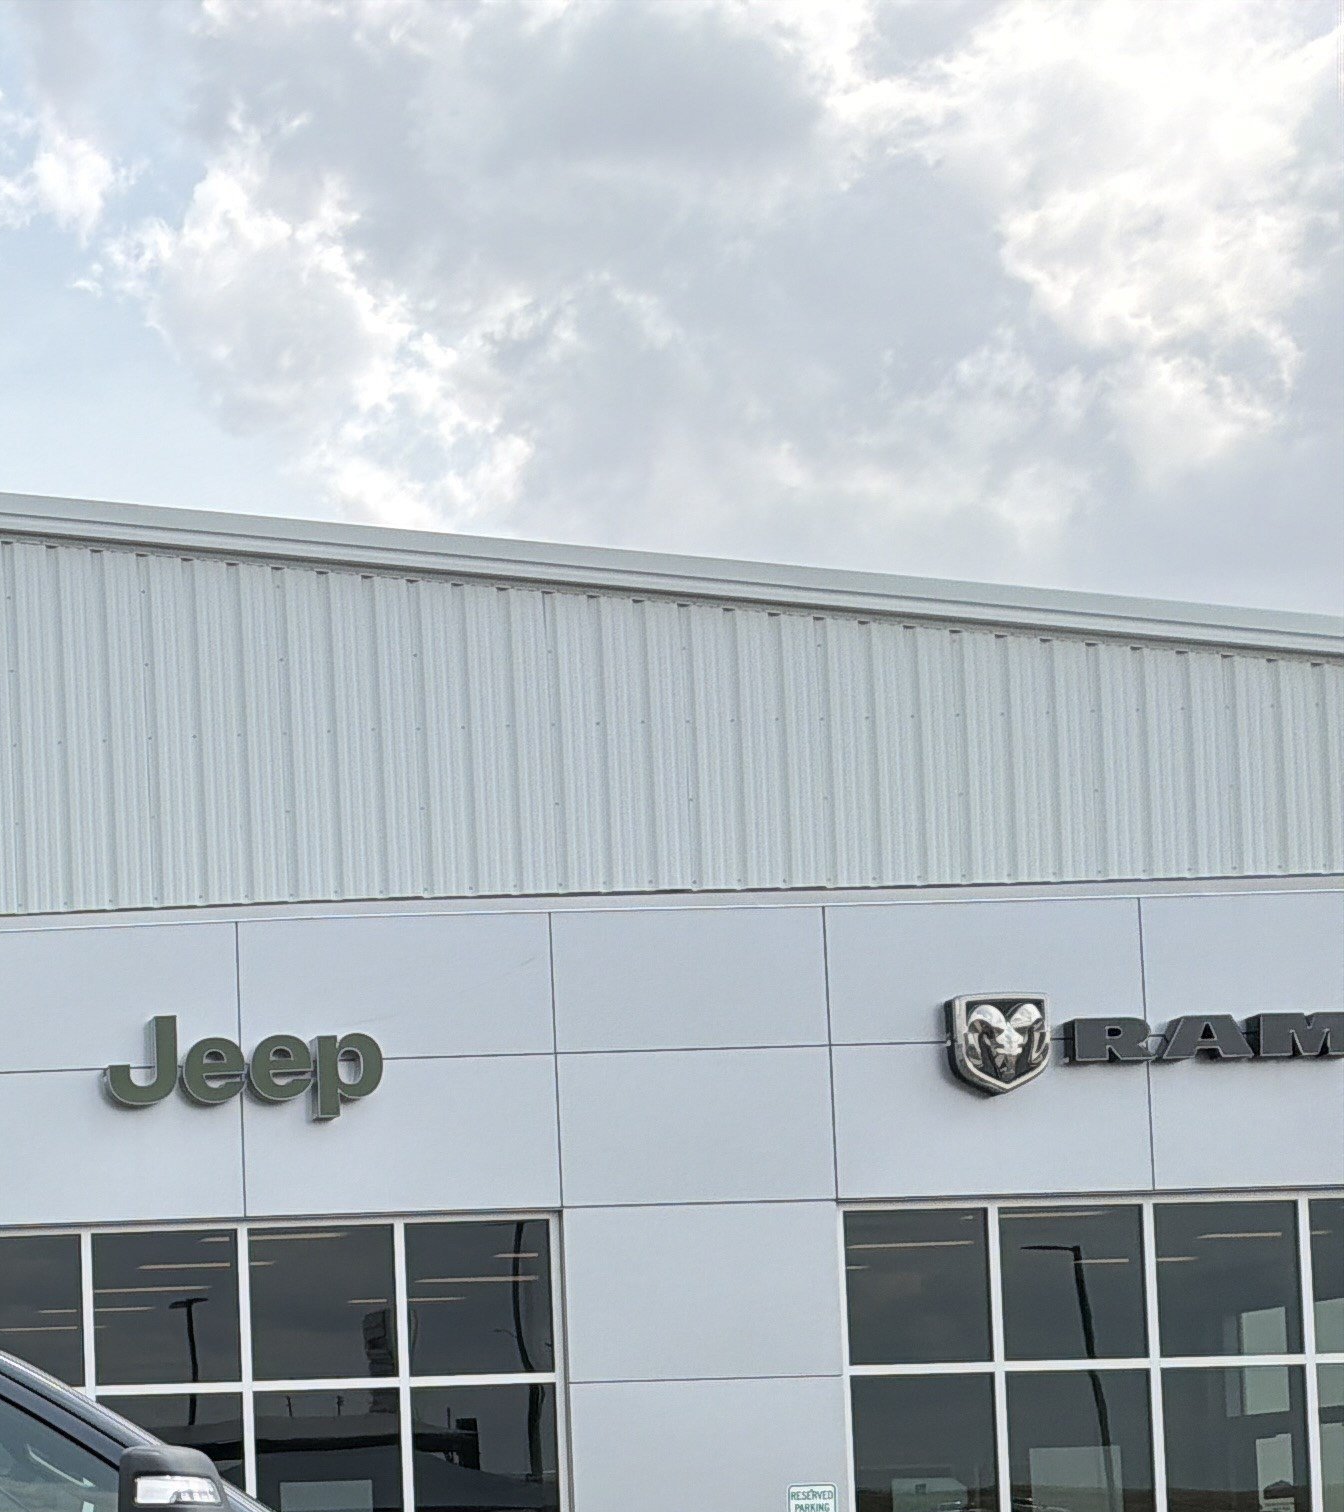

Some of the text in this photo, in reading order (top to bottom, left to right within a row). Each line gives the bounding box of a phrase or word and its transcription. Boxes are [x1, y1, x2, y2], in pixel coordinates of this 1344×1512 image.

[1066, 1010, 1344, 1062] RAM
[103, 1015, 382, 1121] Jeep
[790, 1490, 834, 1501] RESERVED
[794, 1503, 831, 1512] PARKING
